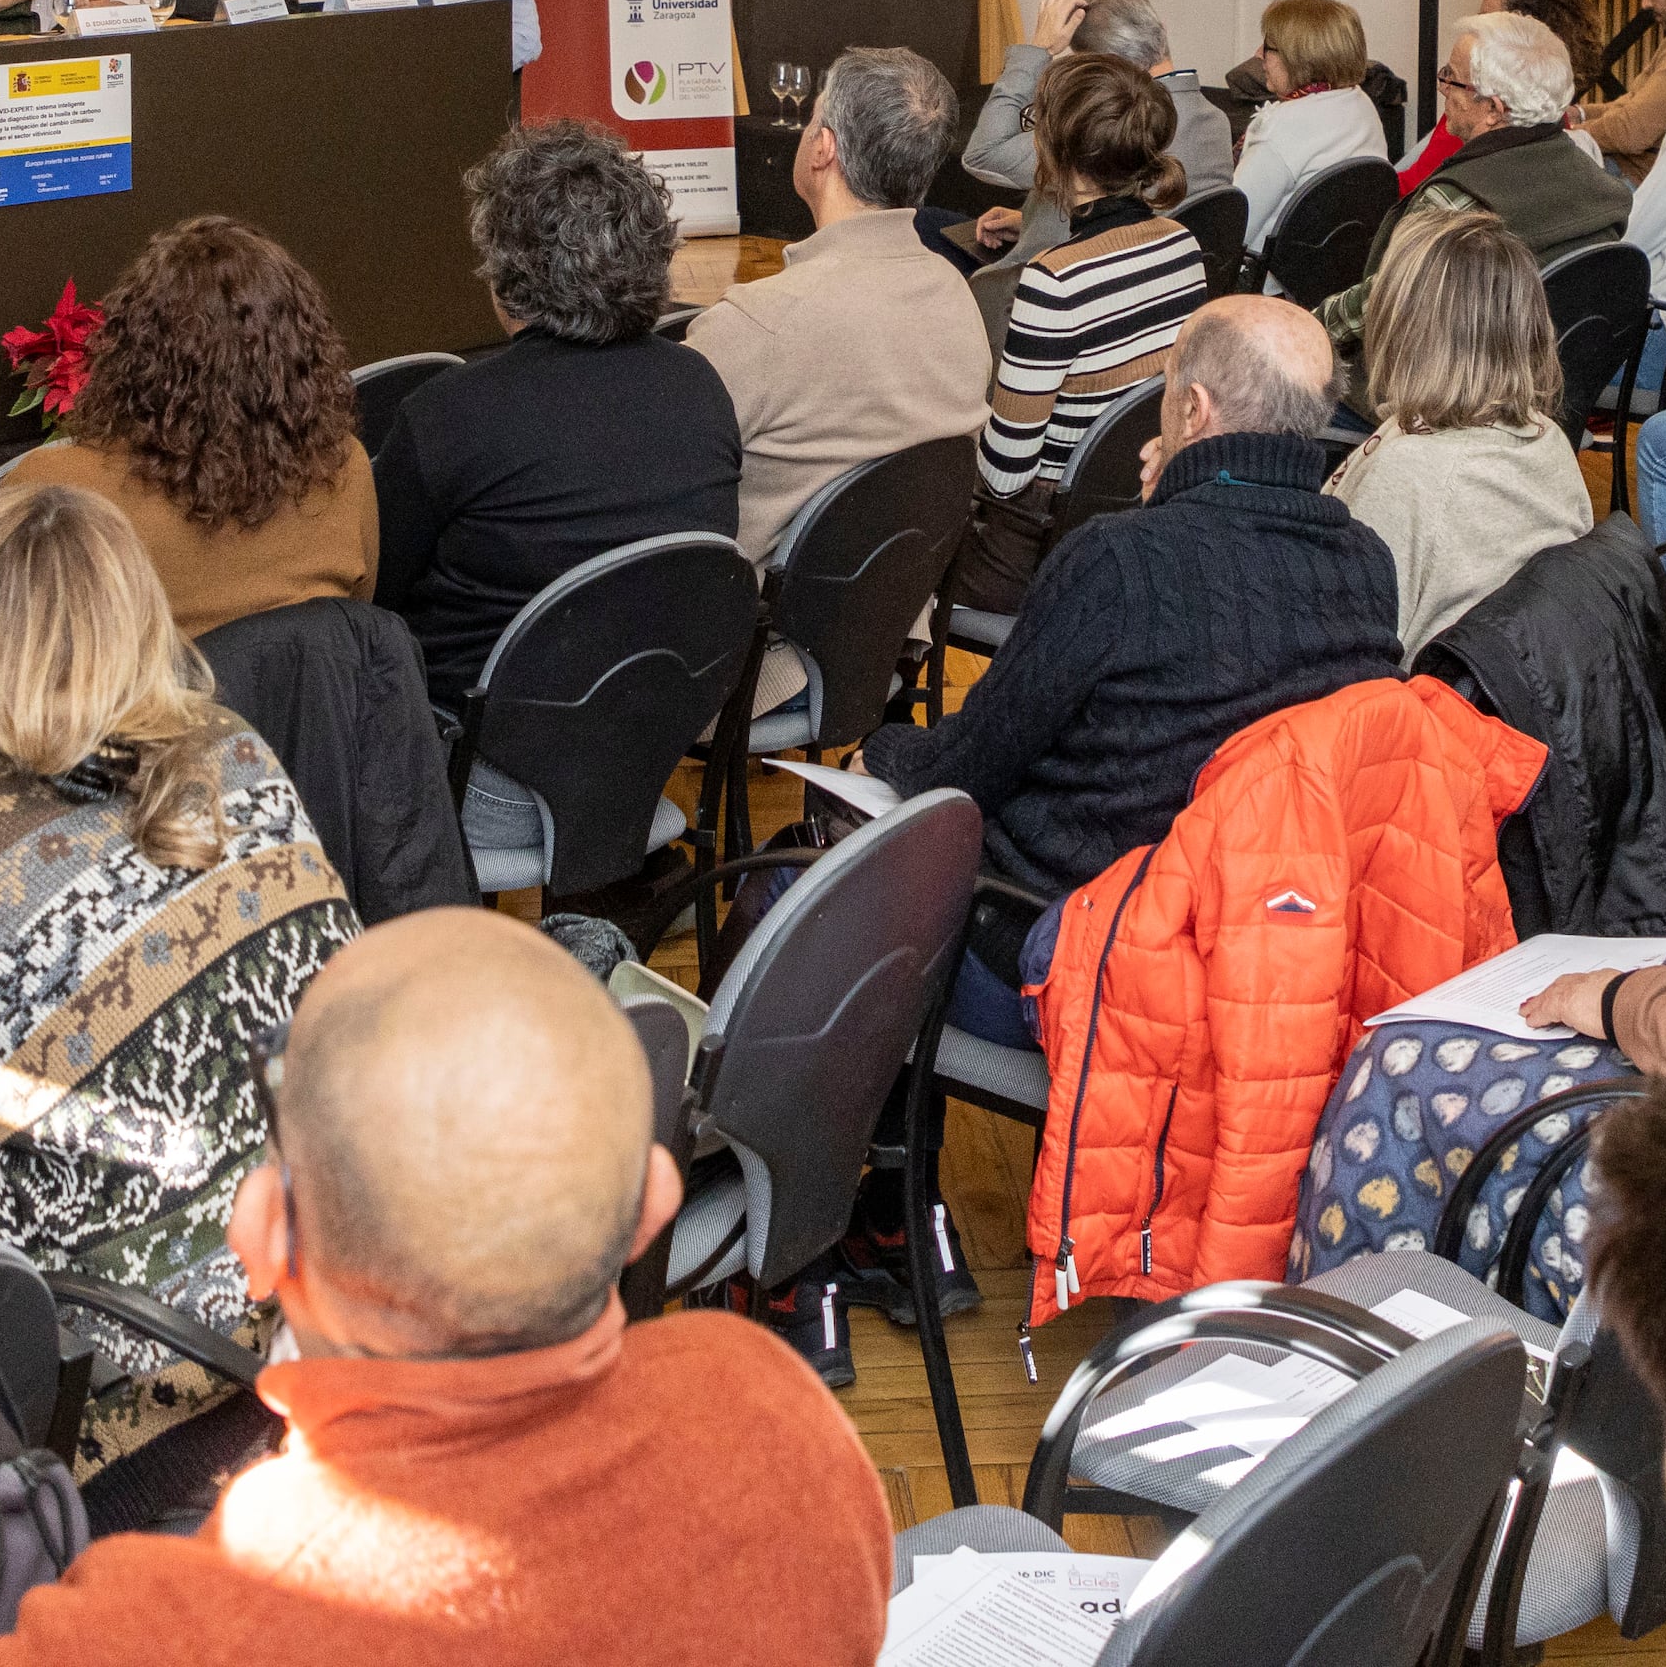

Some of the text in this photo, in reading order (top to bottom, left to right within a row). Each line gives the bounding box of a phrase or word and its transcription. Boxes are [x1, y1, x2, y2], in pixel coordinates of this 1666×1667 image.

[653, 11, 696, 21] Zaragoza
[678, 62, 725, 76] PTV
[58, 101, 85, 109] inteligente
[1034, 1570, 1056, 1578] DIC
